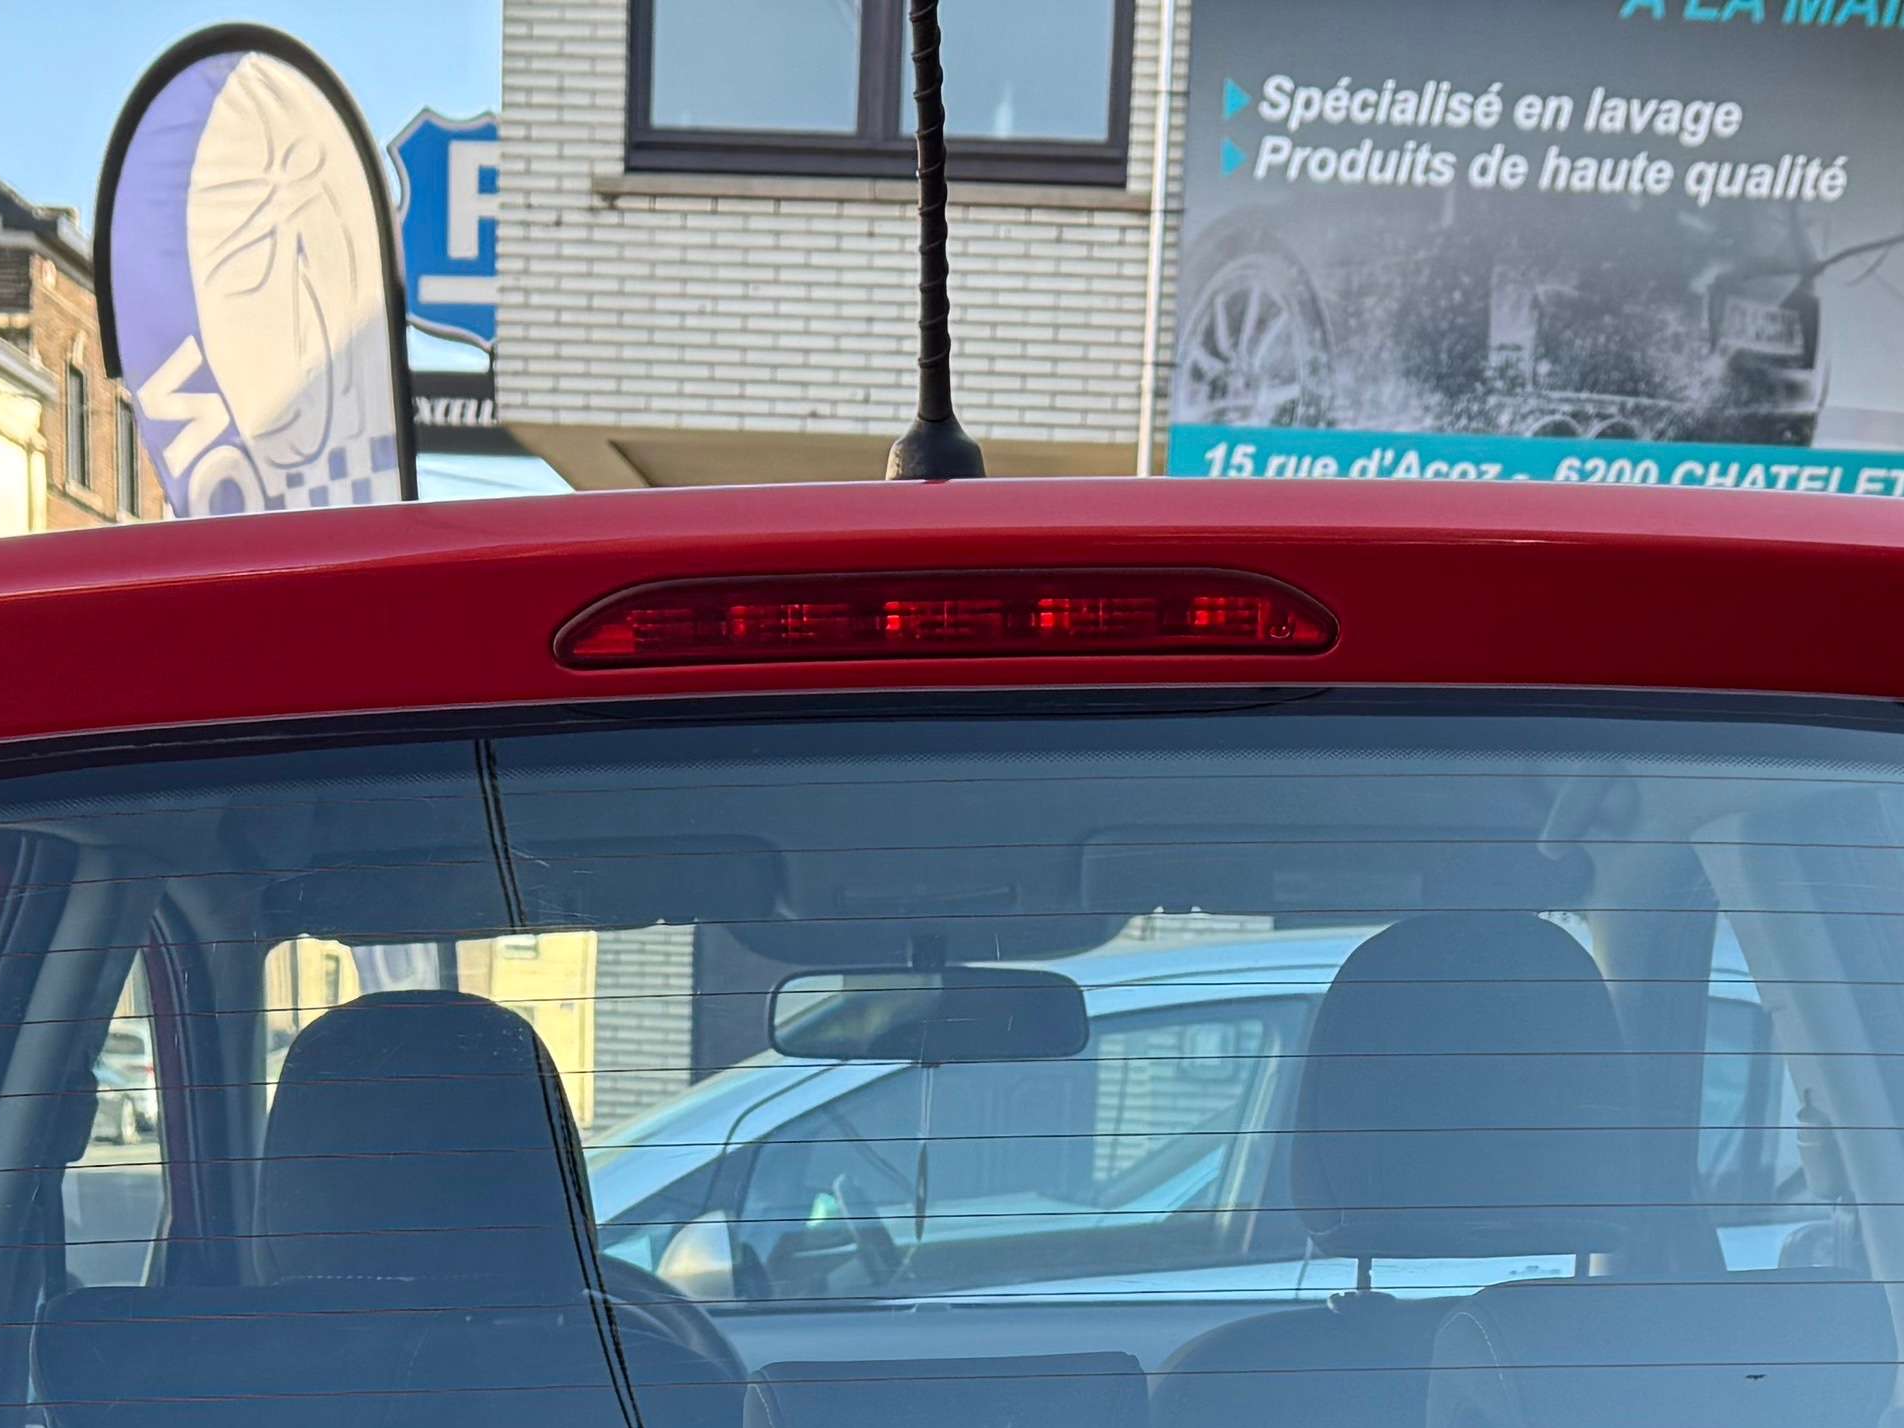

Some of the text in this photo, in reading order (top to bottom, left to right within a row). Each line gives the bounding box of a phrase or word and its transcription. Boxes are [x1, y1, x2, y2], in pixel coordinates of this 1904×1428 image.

[1258, 74, 1743, 147] Spécialisé en lavage
[1253, 135, 1848, 208] Produits de haute qualité
[1204, 441, 1256, 479] 15
[1263, 455, 1339, 480] rue
